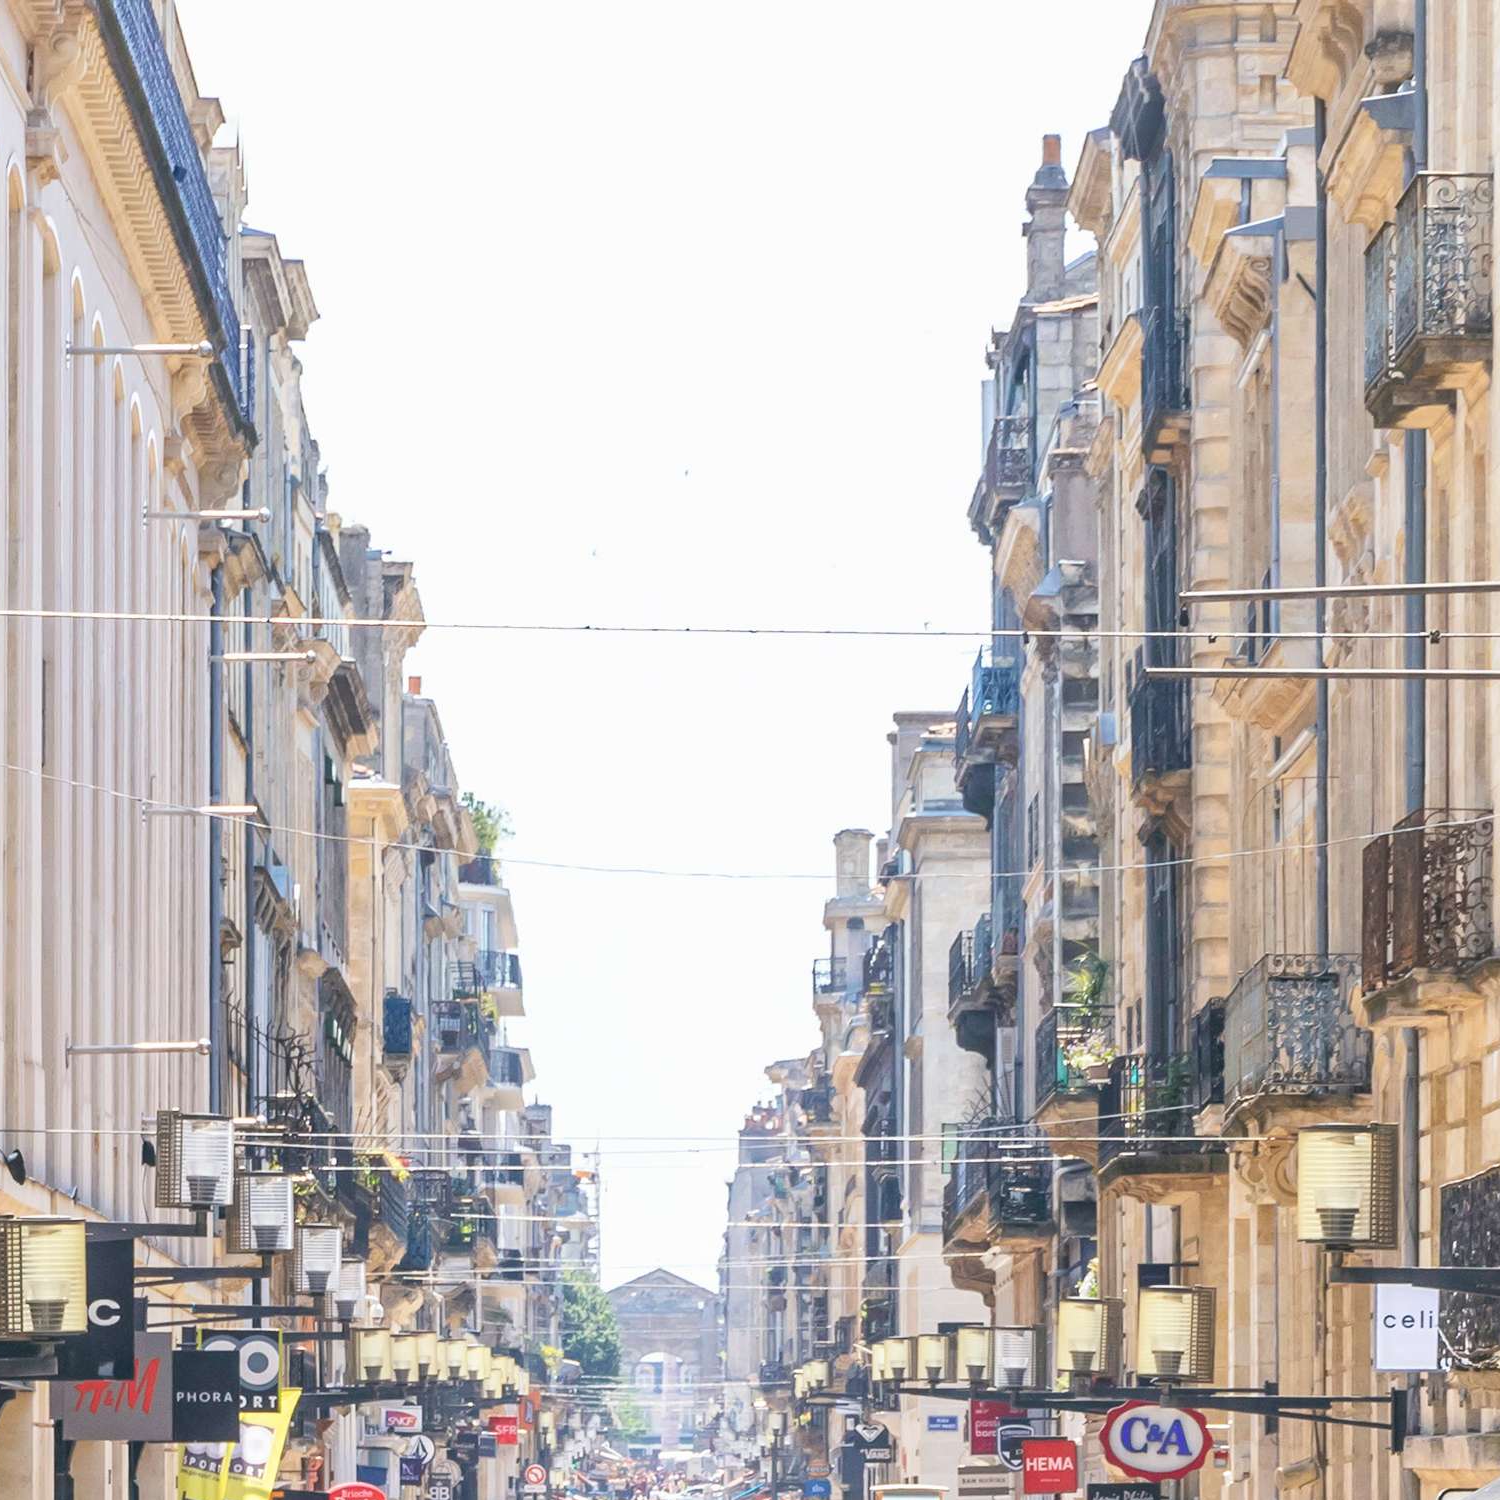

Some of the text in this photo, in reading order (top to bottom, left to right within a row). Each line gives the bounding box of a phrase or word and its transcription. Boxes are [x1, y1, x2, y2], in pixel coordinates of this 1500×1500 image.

[74, 1357, 160, 1416] H&M
[176, 1391, 234, 1404] PHORA
[495, 1424, 518, 1435] SFR
[1120, 1416, 1193, 1457] C&A
[1026, 1456, 1074, 1471] HEMA
